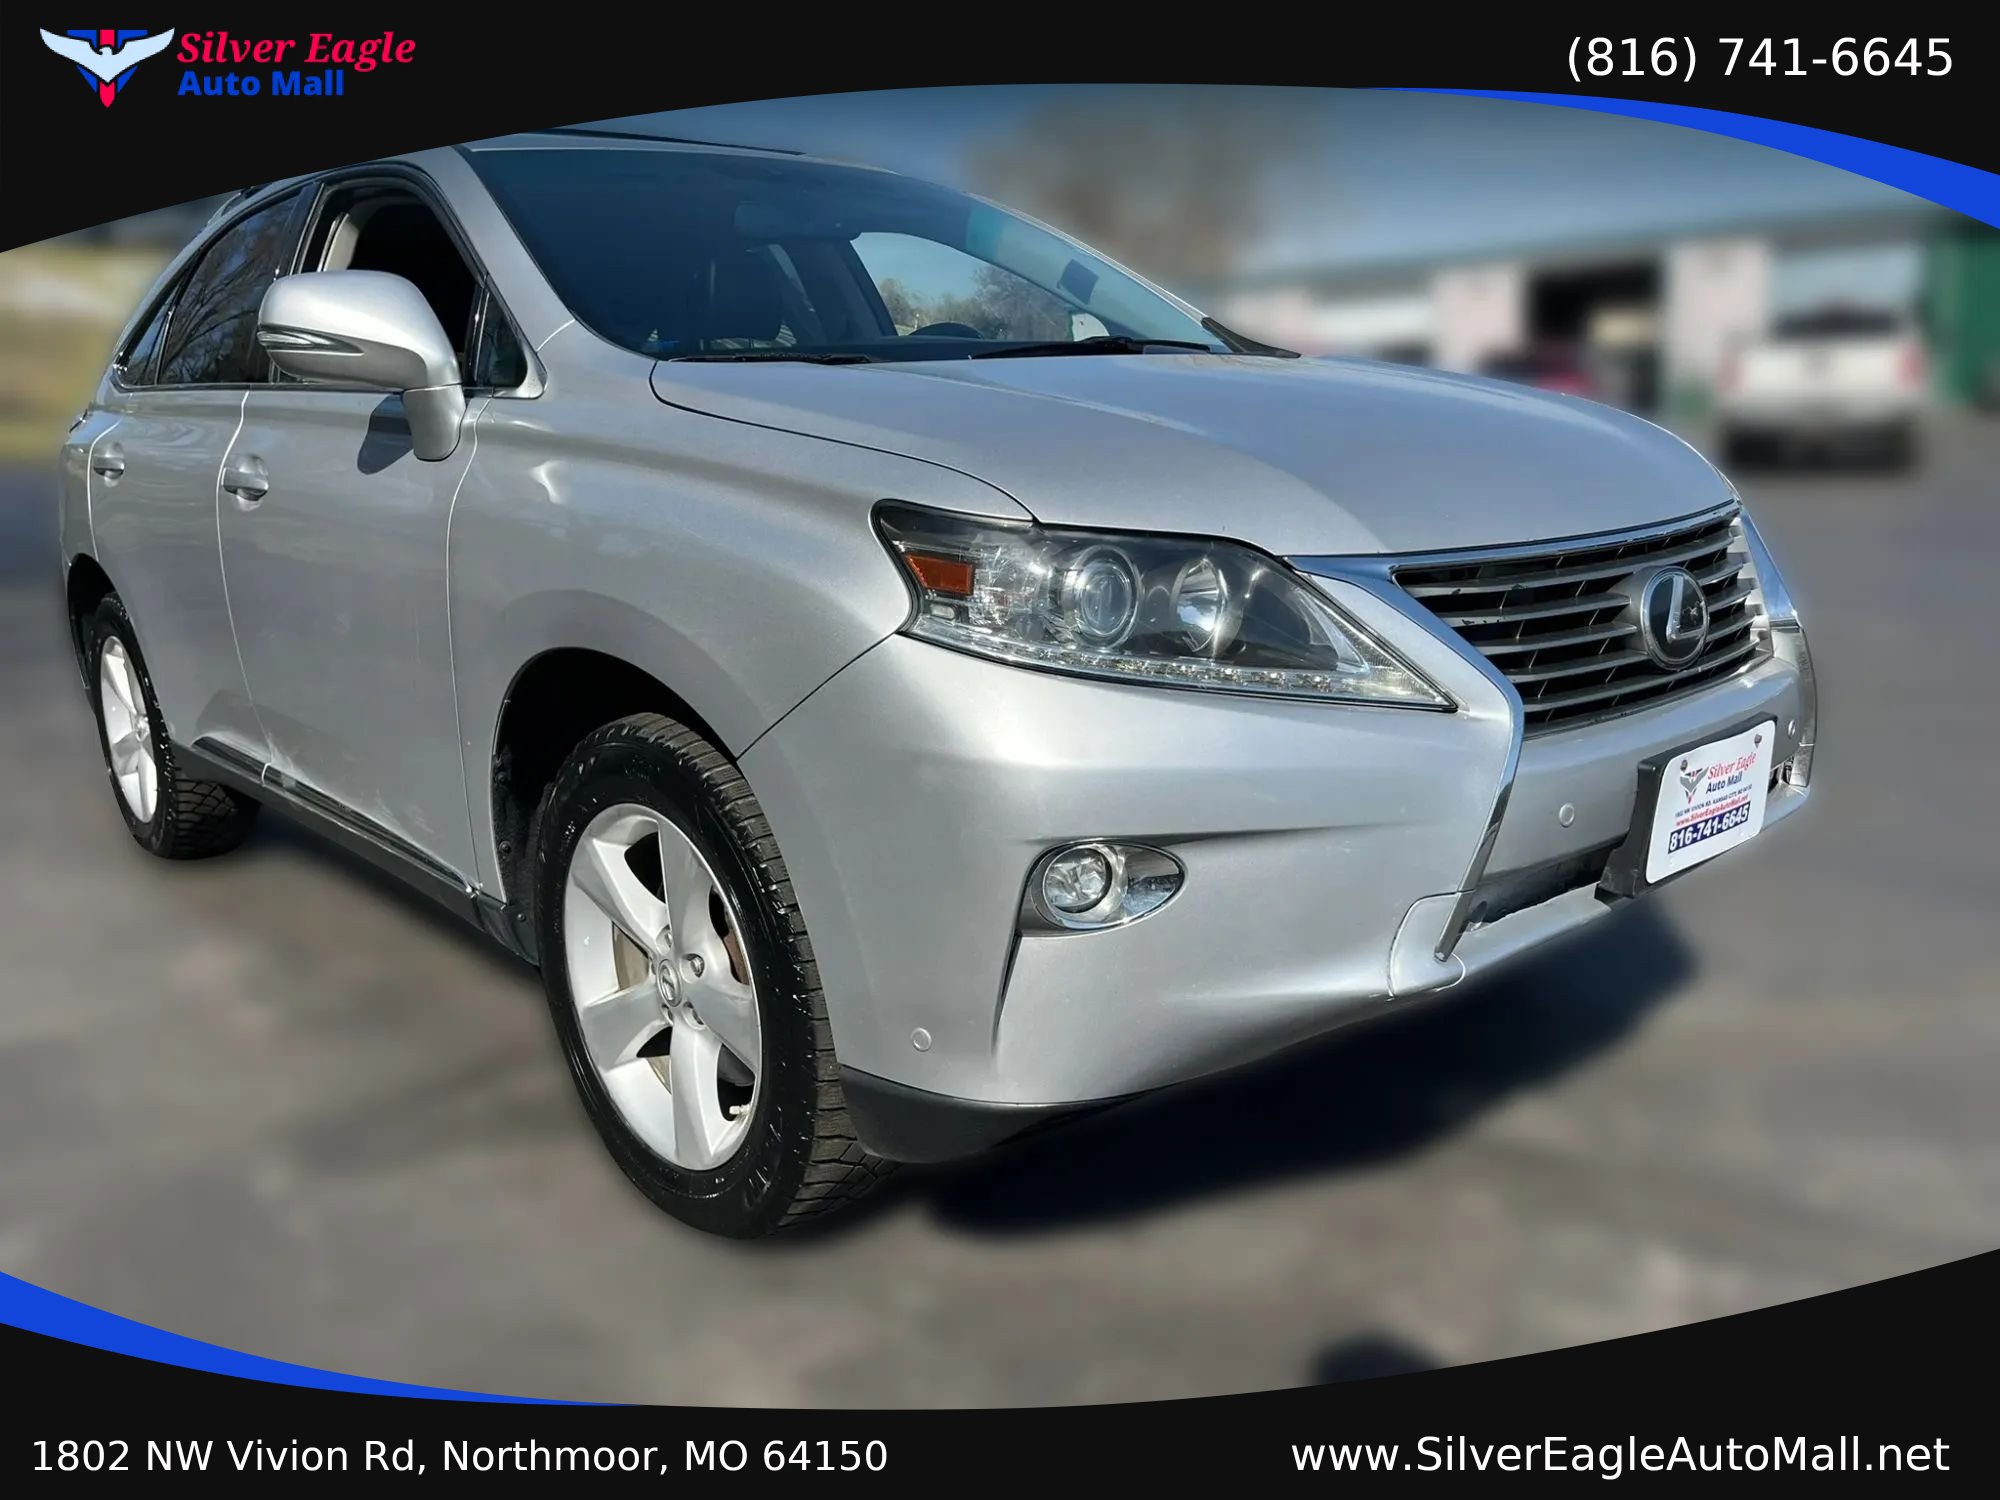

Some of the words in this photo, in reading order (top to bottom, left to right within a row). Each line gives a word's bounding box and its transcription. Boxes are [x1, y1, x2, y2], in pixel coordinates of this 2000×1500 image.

[1707, 763, 1735, 780] Silver
[1734, 752, 1757, 772] Eagle
[1706, 781, 1726, 794] Auto
[1726, 771, 1743, 787] Mall
[1669, 803, 1750, 852] 816-741-6645
